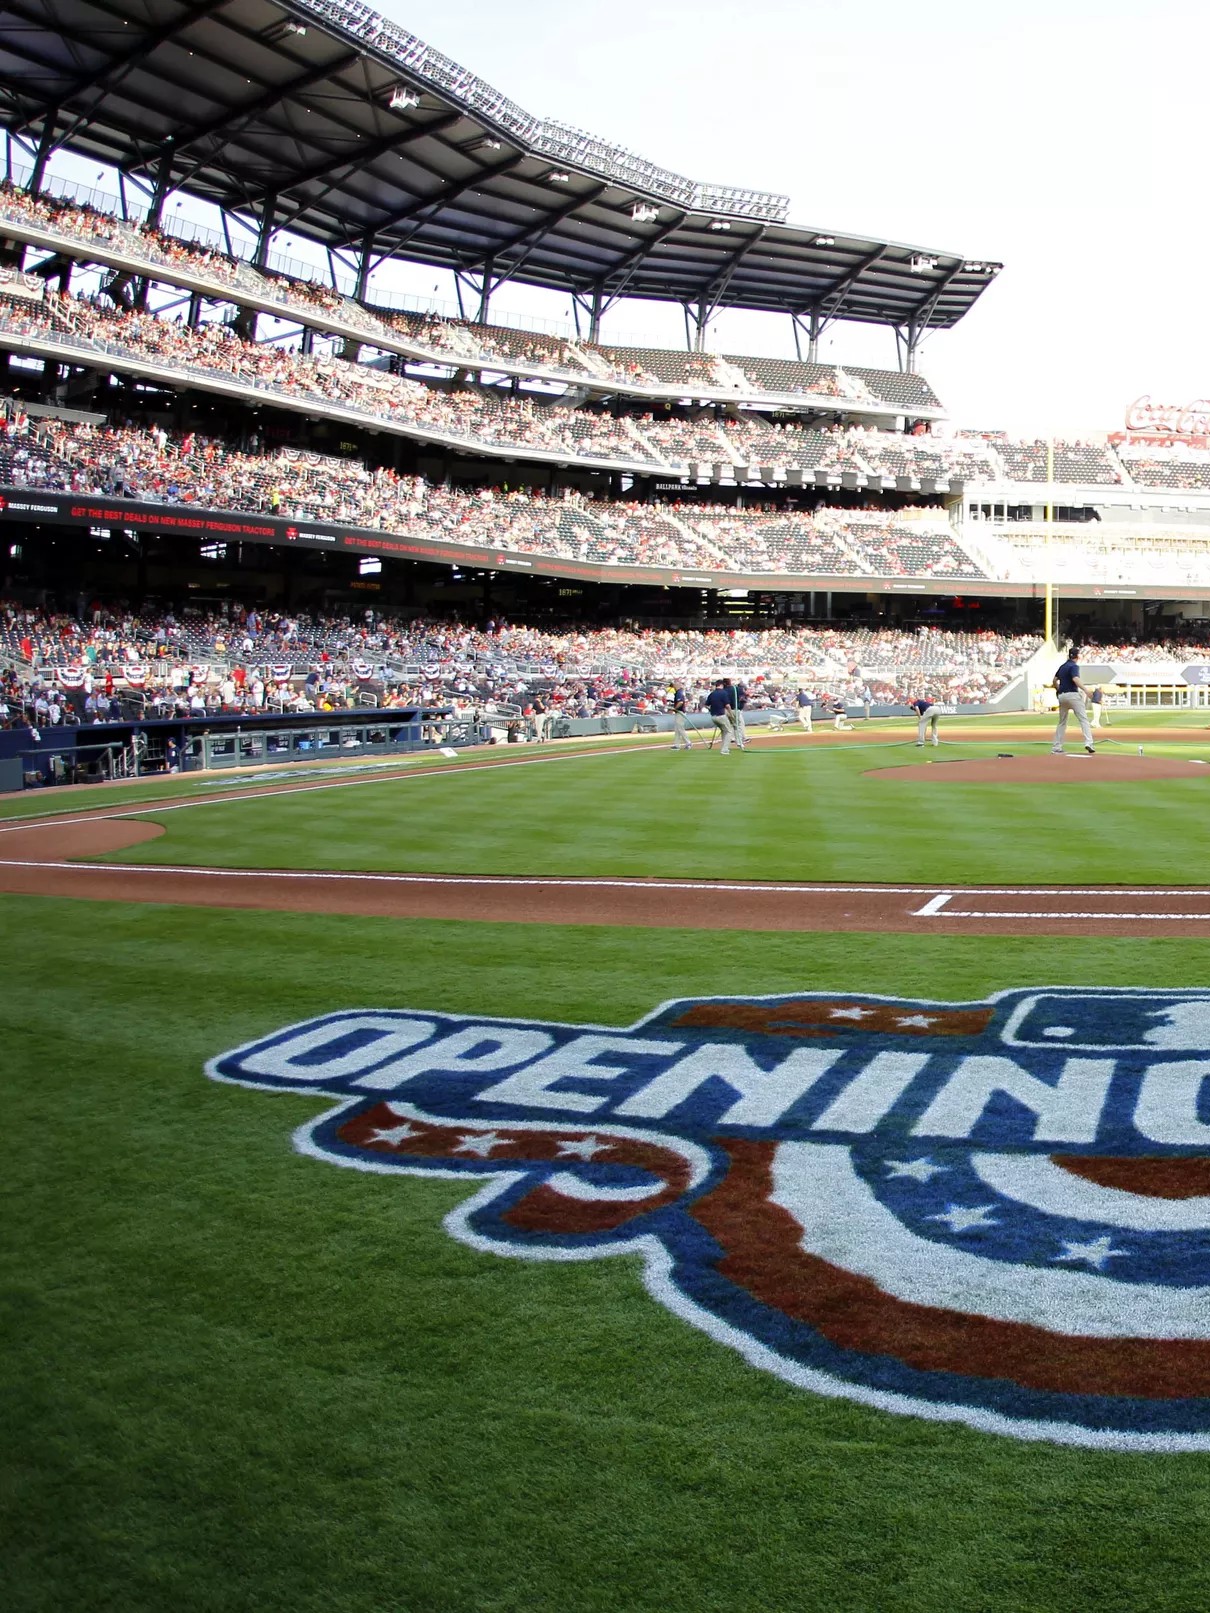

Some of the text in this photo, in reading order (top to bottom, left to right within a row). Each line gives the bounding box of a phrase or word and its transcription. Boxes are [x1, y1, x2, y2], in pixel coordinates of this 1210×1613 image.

[8, 502, 58, 513] MASSEY FERGUSON
[71, 506, 86, 517] GET
[88, 508, 103, 519] THE
[104, 510, 123, 520] BEST
[124, 511, 147, 523] DEALS
[148, 514, 159, 524] ON
[160, 516, 176, 526] NEW
[177, 517, 204, 529] MASSEY
